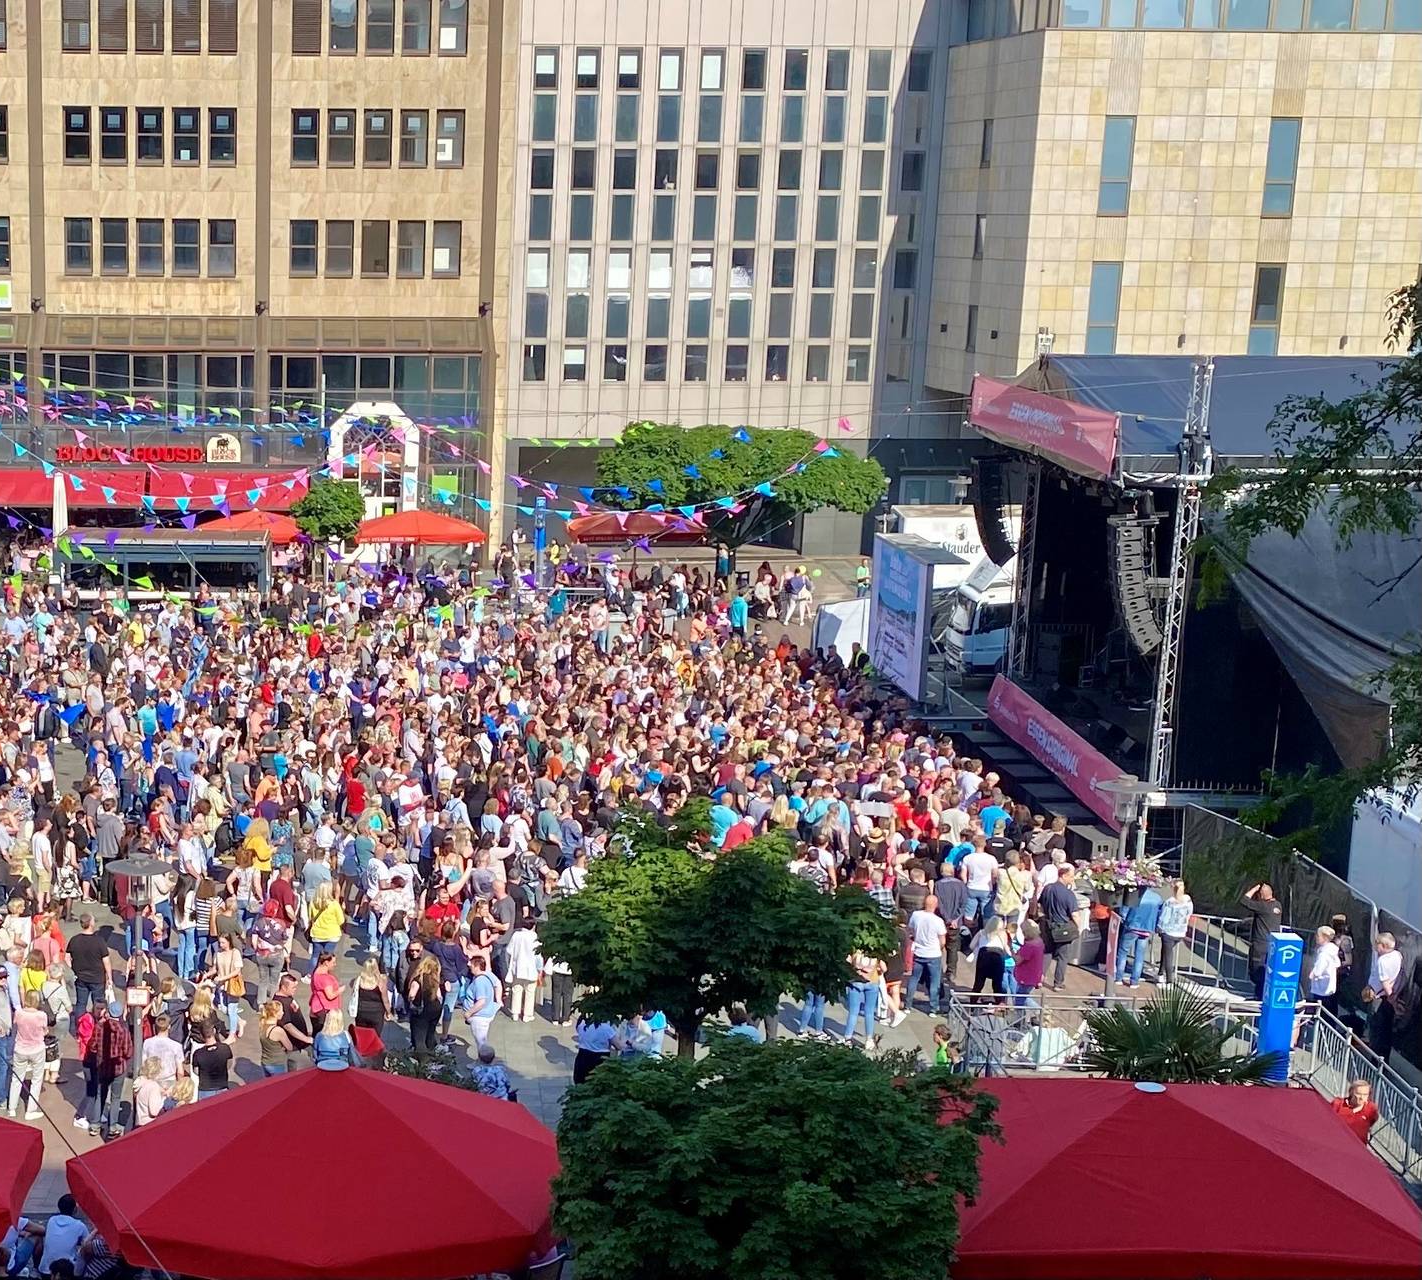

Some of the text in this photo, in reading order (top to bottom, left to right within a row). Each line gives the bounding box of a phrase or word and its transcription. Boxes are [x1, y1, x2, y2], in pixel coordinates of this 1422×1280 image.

[131, 446, 203, 463] HOUSE
[1282, 950, 1295, 964] P
[1276, 990, 1289, 1002] A
